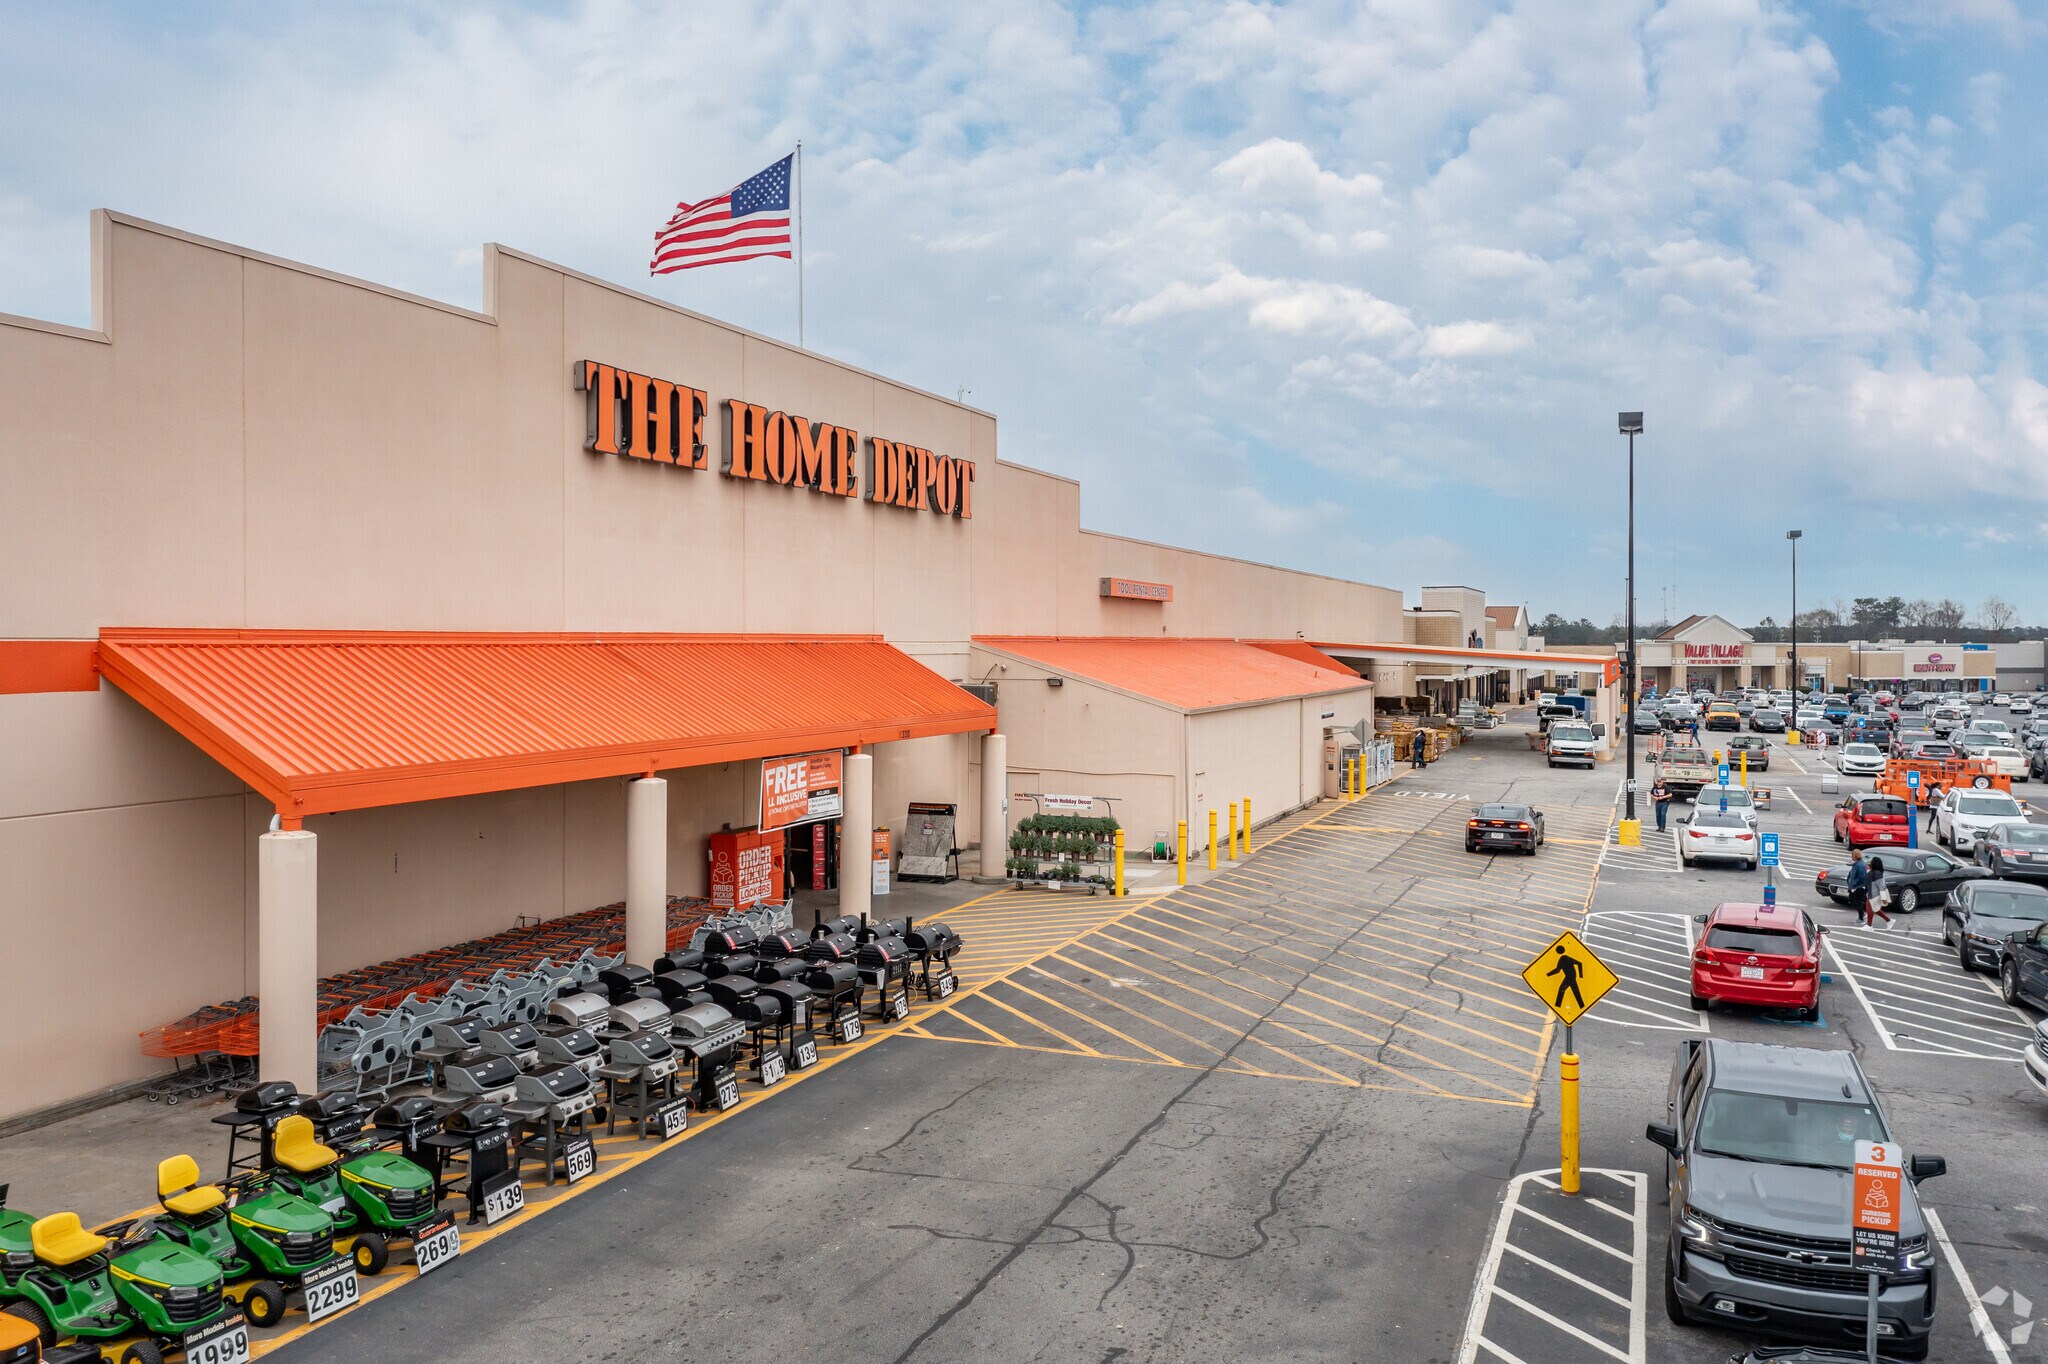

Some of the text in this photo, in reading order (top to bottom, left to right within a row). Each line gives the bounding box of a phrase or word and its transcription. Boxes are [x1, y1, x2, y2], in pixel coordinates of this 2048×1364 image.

[583, 359, 976, 520] THE HOME DEPOT
[1118, 582, 1169, 598] TOOL RENTAL CENTER
[1684, 643, 1745, 658] VALUE VILLAGE
[766, 760, 807, 795] FREE
[776, 788, 808, 806] INCLUSIVE
[1394, 790, 1470, 801] YIELD
[738, 846, 772, 870] ORDER
[738, 863, 772, 887] PICKUP
[713, 884, 734, 892] ORDER
[740, 883, 771, 900] LOCKERS
[845, 1020, 860, 1037] 179
[800, 1044, 816, 1062] 139
[721, 1083, 738, 1105] 279
[667, 1109, 686, 1131] 459
[1870, 1146, 1886, 1162] 3
[569, 1151, 591, 1176] 569
[1857, 1167, 1898, 1179] RESERVED
[487, 1184, 522, 1212] $139
[1861, 1209, 1891, 1218] CURBSIDE
[1861, 1216, 1891, 1226] PICKUP
[1856, 1237, 1895, 1248] YOU'RE HERE
[1877, 1233, 1896, 1241] KNOW
[417, 1230, 459, 1268] 2699
[304, 1258, 354, 1285] More Models Inside
[308, 1275, 357, 1315] 2299
[186, 1314, 244, 1345] More Models Inside
[190, 1331, 248, 1364] 1999
